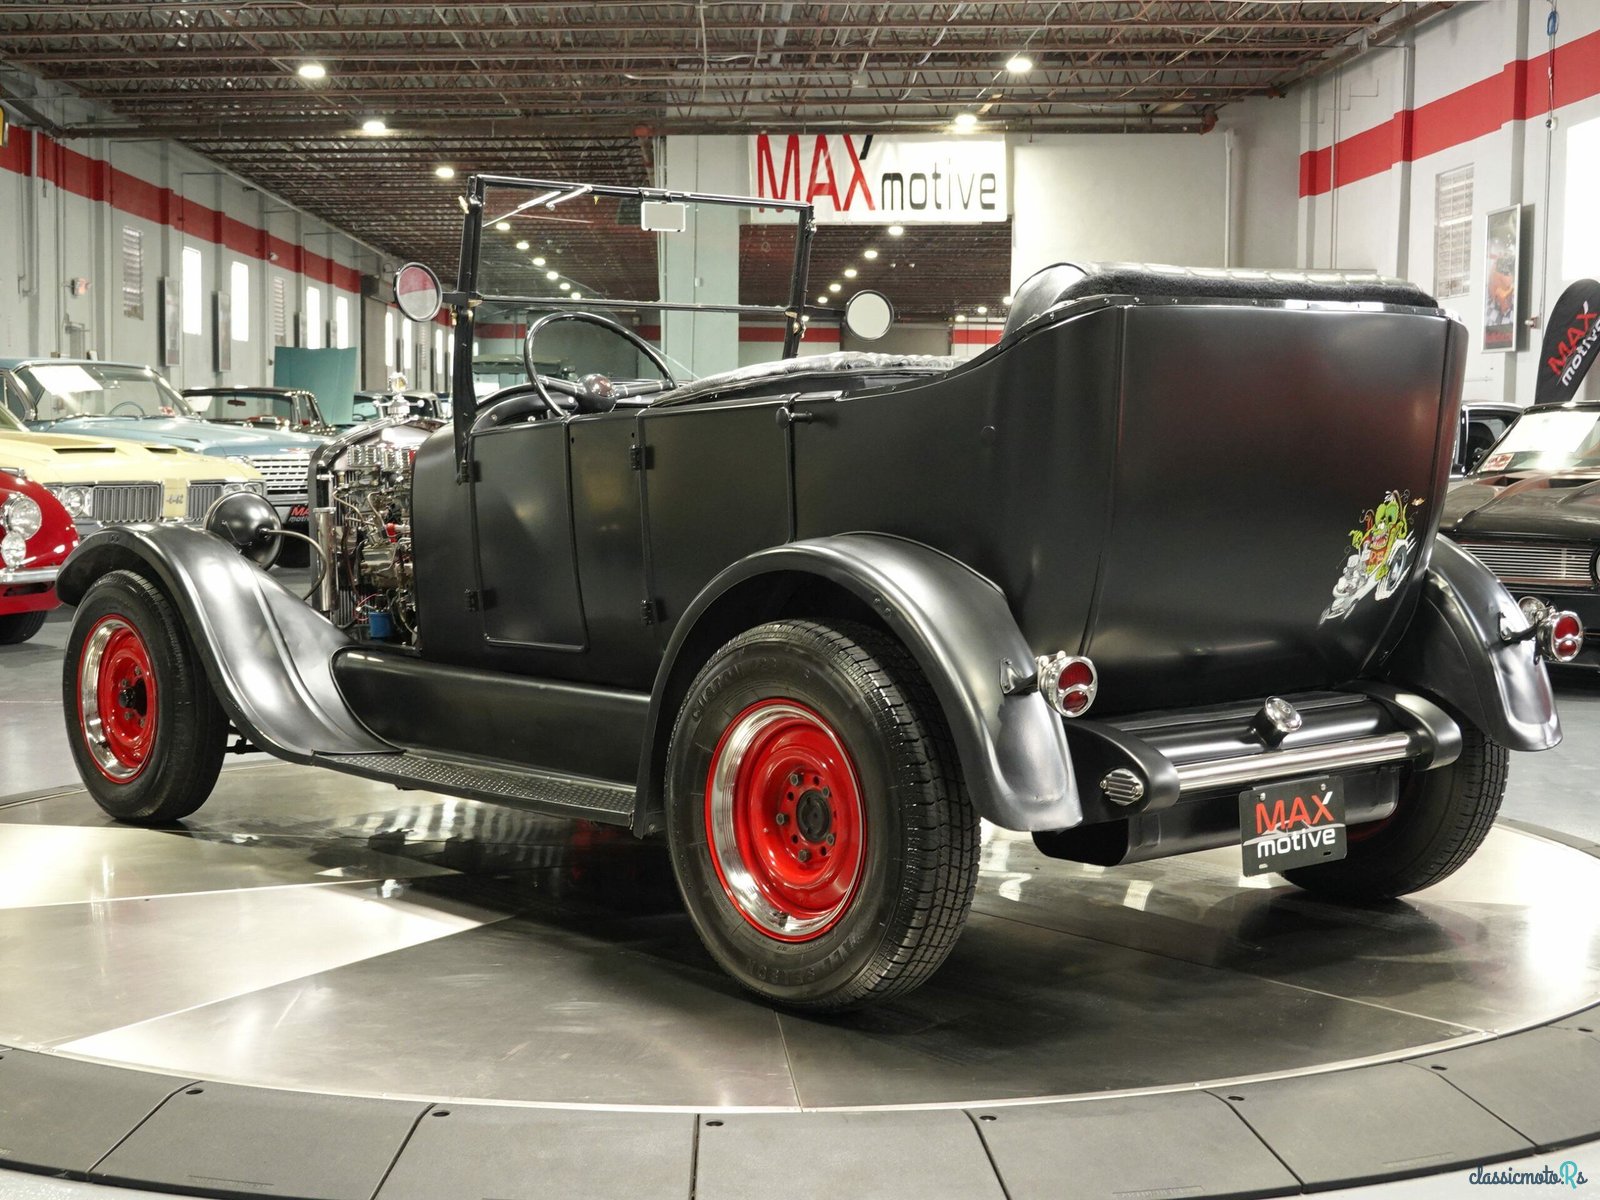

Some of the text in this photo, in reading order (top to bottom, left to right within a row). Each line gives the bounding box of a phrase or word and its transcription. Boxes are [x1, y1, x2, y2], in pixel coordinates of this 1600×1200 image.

[756, 134, 996, 213] MAX motive
[1547, 301, 1598, 376] MAX
[291, 507, 310, 516] MA
[1255, 791, 1334, 835] MAX
[1257, 828, 1336, 858] motive
